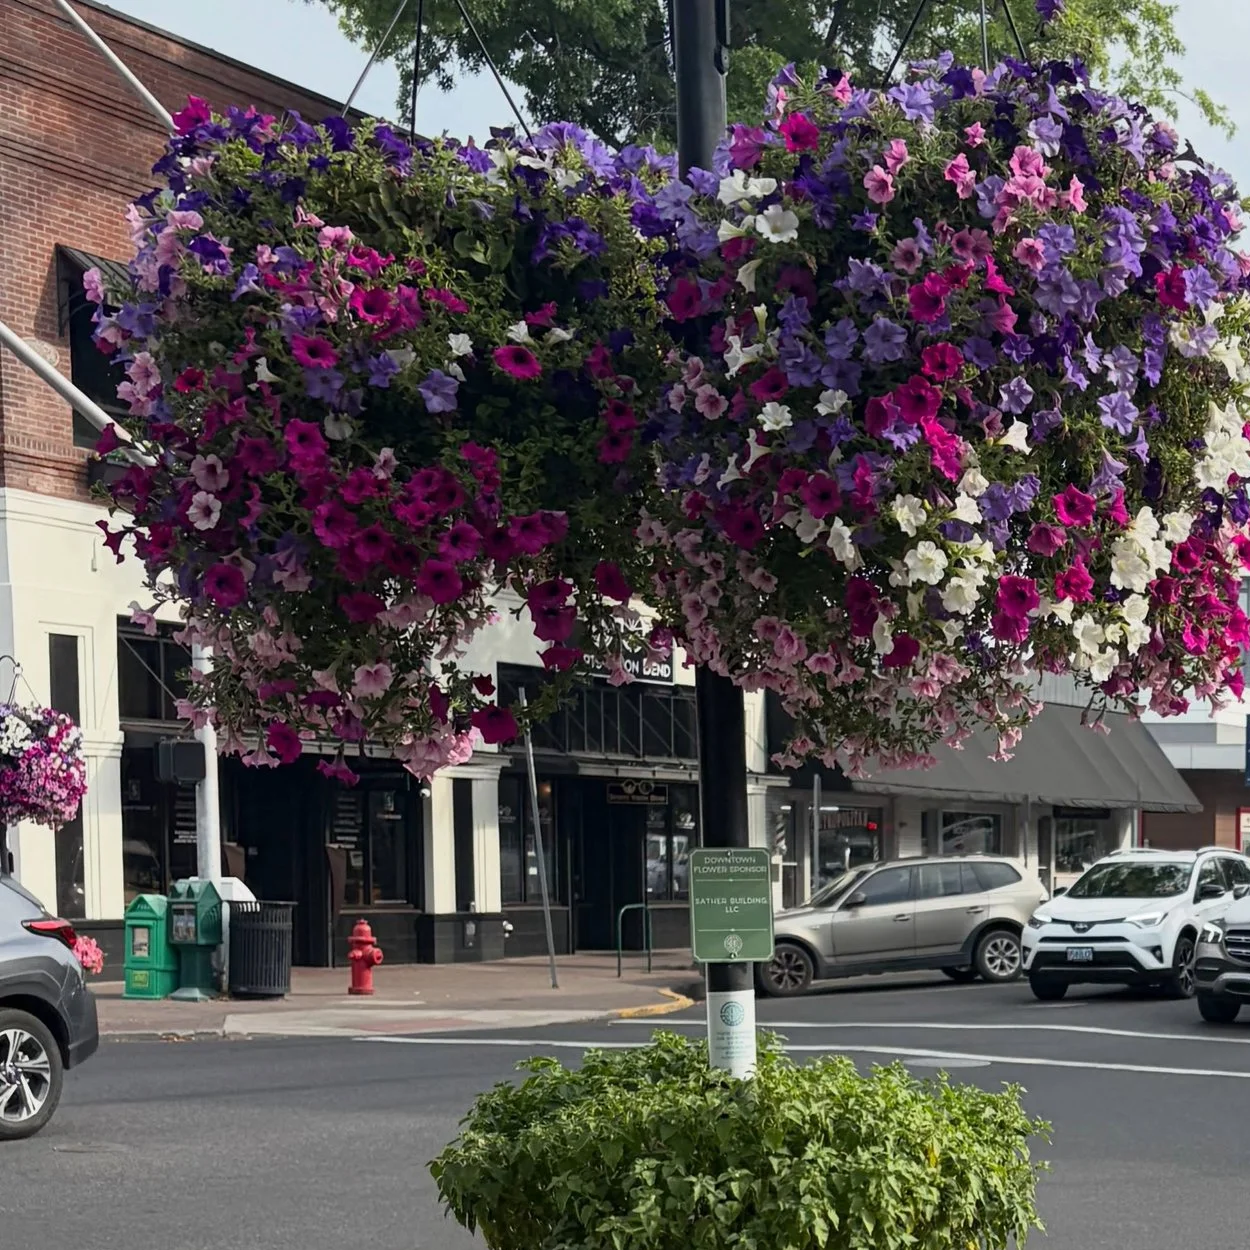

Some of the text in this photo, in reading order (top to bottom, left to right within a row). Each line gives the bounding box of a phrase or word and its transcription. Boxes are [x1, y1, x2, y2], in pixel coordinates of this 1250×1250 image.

[704, 856, 757, 864] DOWNTOWN
[695, 897, 768, 905] SATHER BUILDING
[724, 905, 740, 913] LLC
